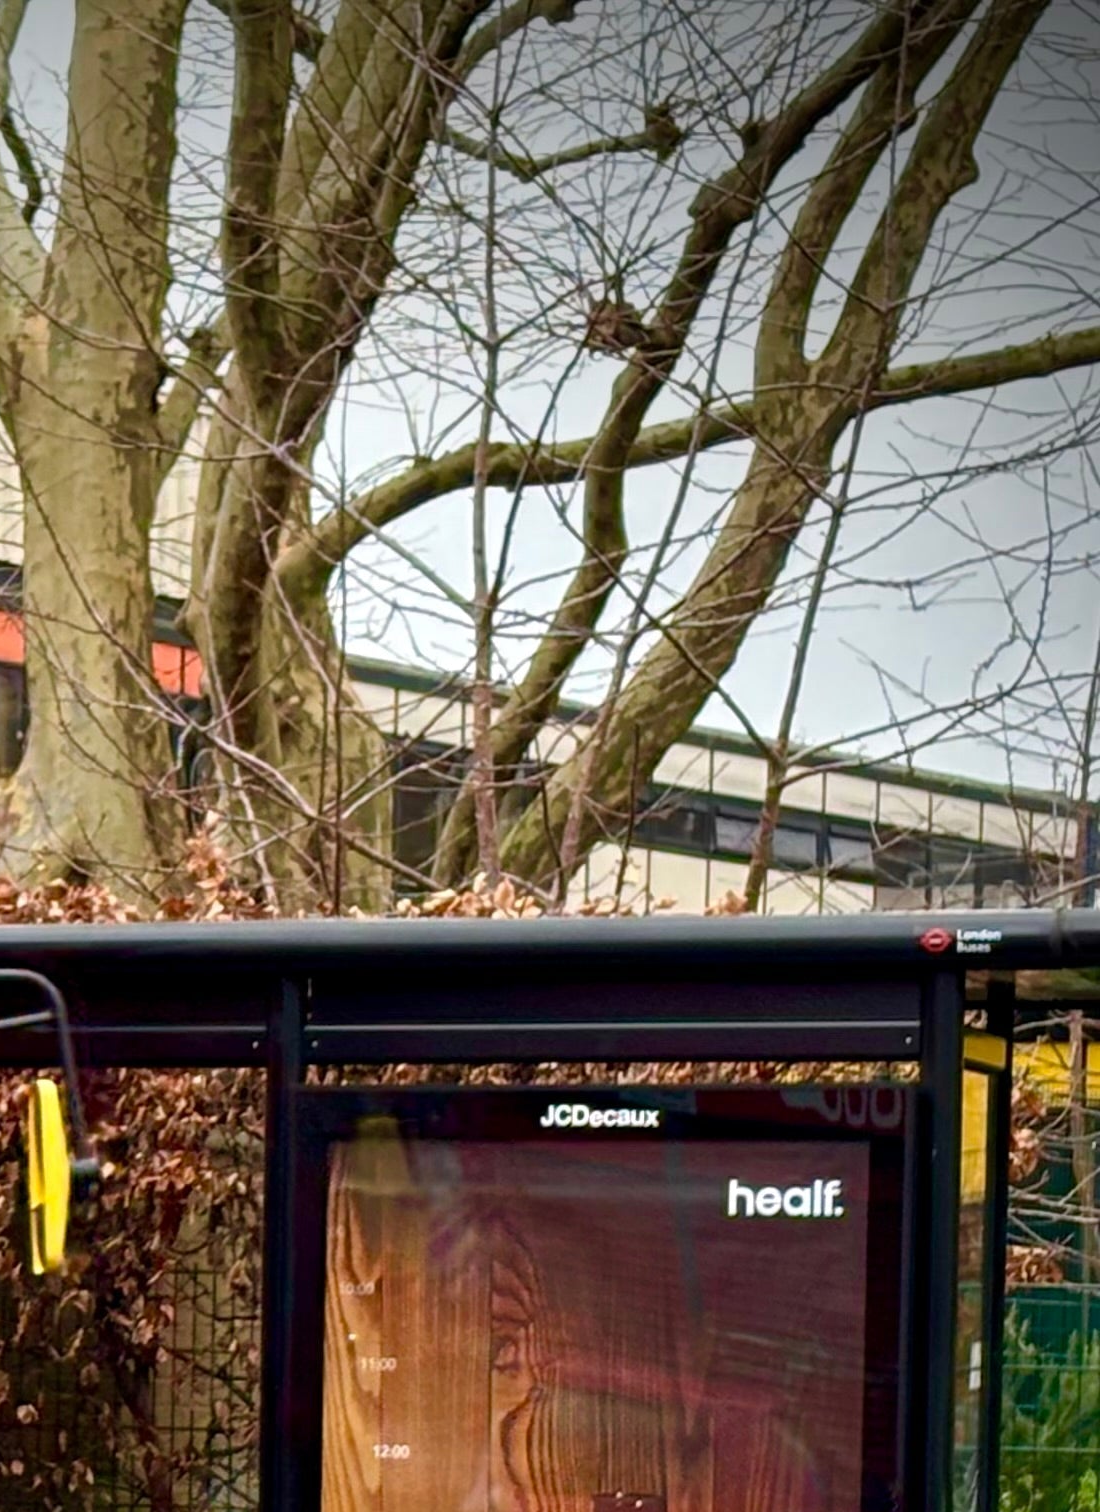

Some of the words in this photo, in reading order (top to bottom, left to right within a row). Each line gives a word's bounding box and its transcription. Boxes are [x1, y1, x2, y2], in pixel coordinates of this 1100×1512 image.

[956, 928, 1002, 941] London
[956, 941, 991, 953] Buses
[540, 1104, 660, 1128] JCDecaux
[727, 1179, 844, 1217] healf.
[360, 1356, 397, 1371] 11:00
[372, 1444, 411, 1459] 12:00
